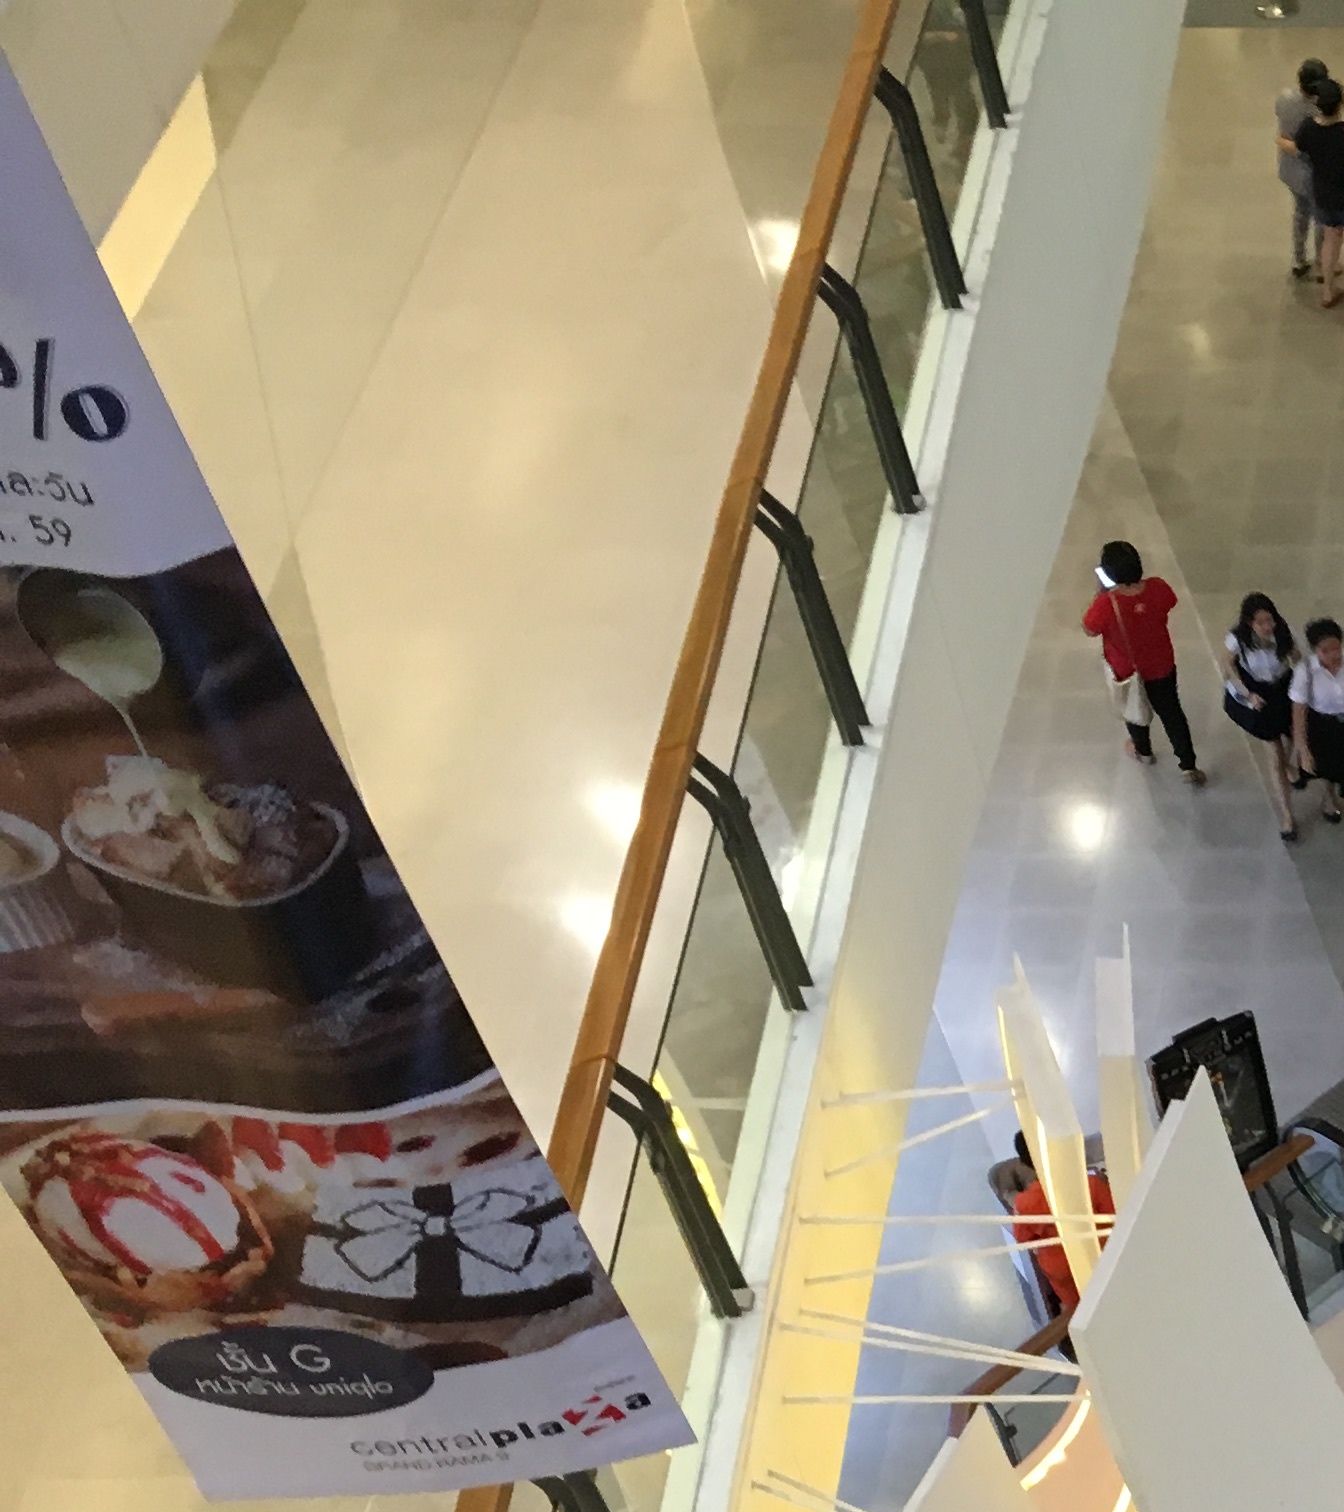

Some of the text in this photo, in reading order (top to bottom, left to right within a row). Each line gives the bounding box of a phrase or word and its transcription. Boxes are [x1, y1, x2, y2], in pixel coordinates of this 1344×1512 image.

[29, 514, 72, 547] 59
[289, 1343, 332, 1374] G
[310, 1372, 395, 1400] uniqlo
